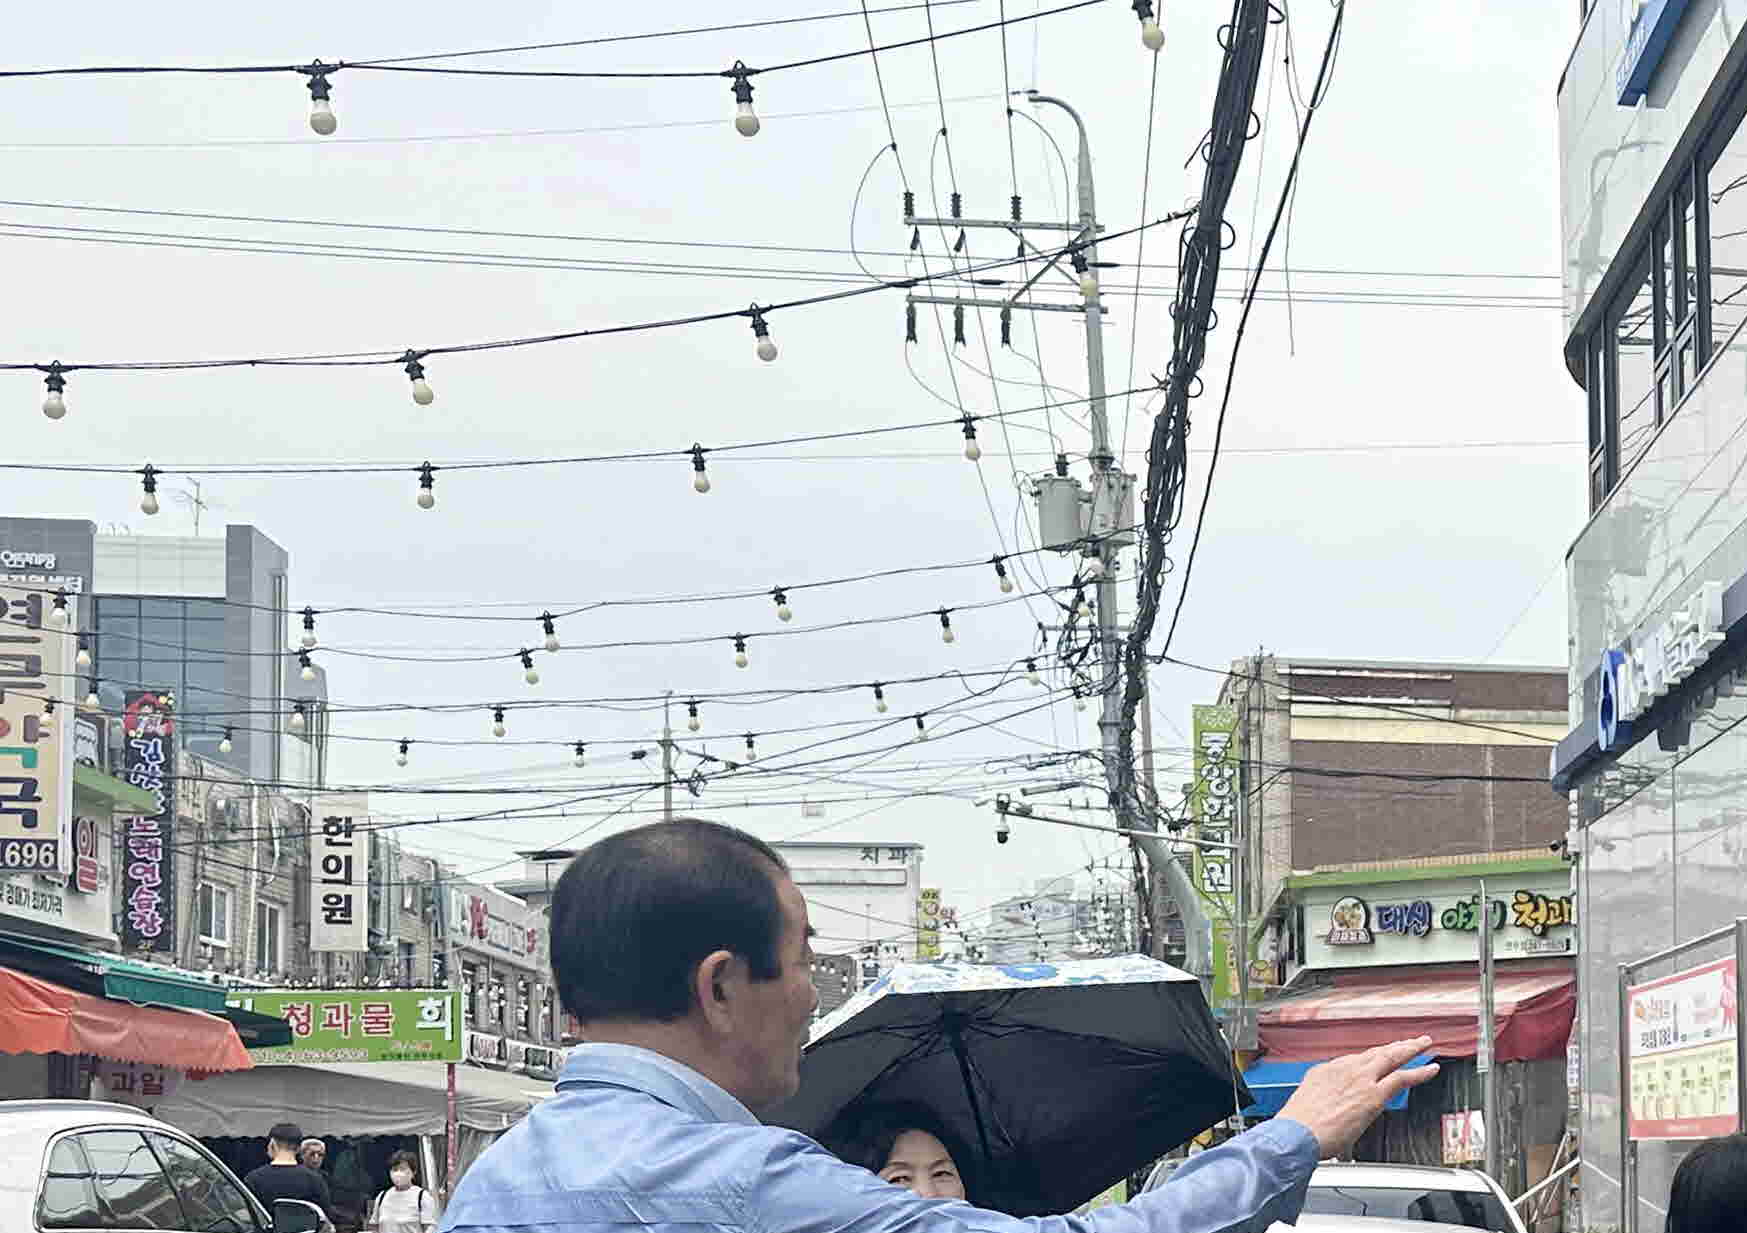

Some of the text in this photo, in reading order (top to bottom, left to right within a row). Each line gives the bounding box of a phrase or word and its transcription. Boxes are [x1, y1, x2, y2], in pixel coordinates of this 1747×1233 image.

[0, 843, 54, 868] 696
[321, 815, 353, 924] 한의원
[280, 1001, 394, 1038] 청과물
